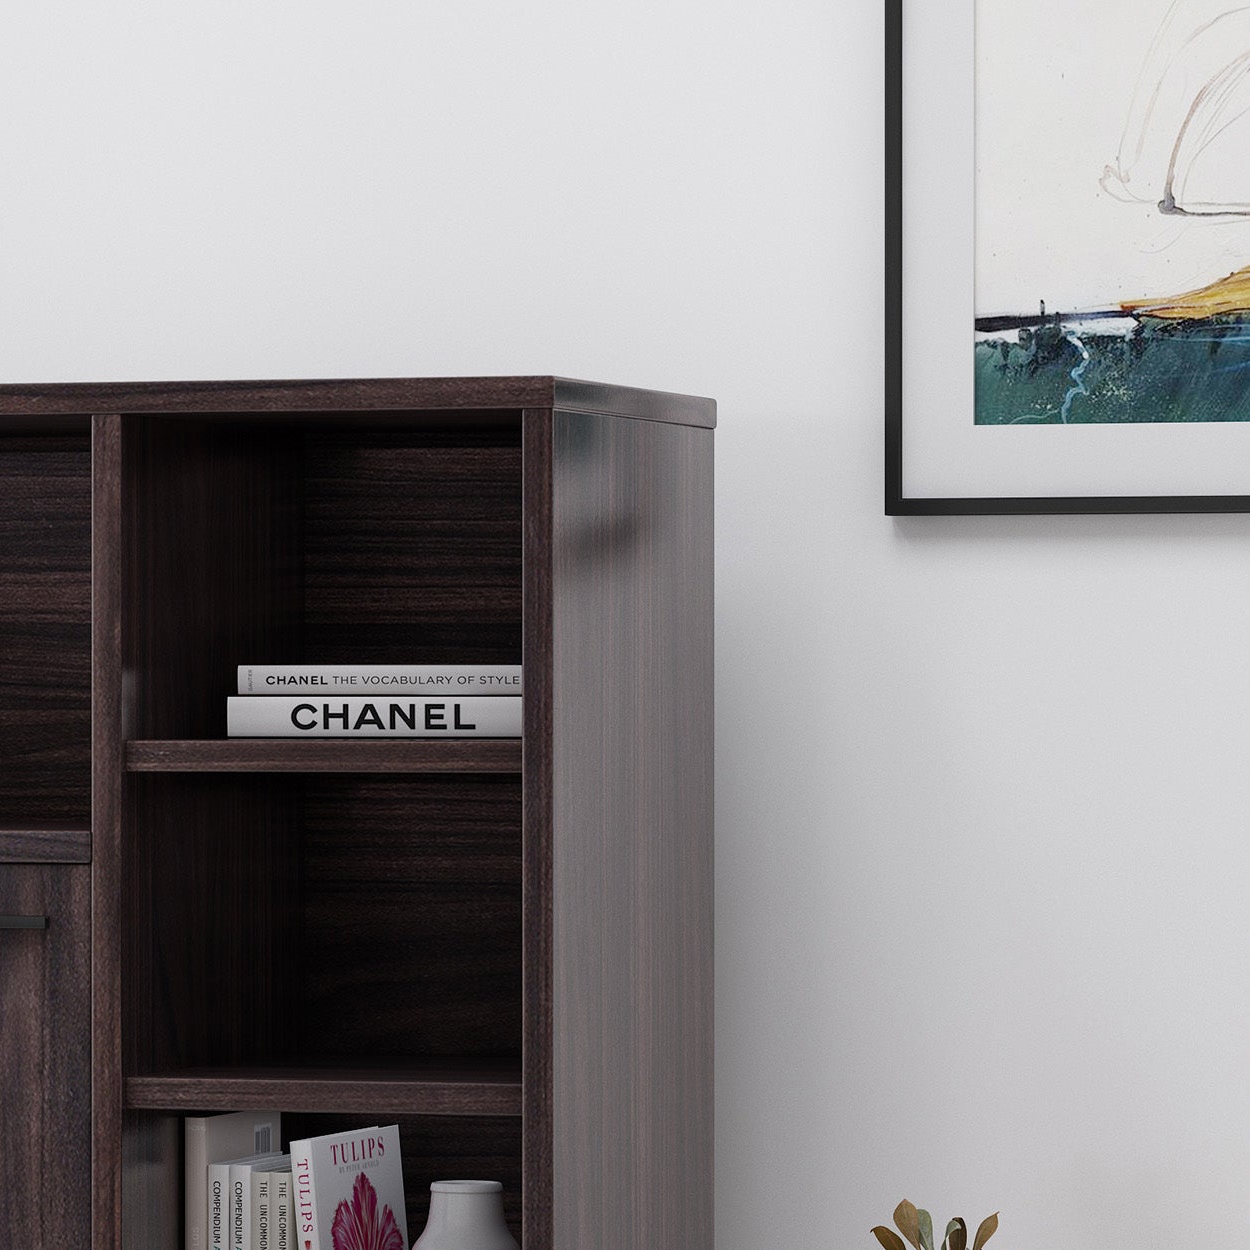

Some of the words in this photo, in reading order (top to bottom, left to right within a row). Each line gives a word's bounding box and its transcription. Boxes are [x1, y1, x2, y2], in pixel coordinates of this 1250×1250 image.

[265, 675, 328, 685] CHANEL
[333, 675, 358, 685] THE
[362, 675, 453, 685] VOCABULARY
[457, 675, 475, 685] OF
[479, 675, 520, 685] STYLE
[291, 703, 476, 730] CHANEL
[330, 1136, 385, 1165] TULIPS
[260, 1182, 268, 1198] THE
[278, 1182, 286, 1198] THE
[297, 1159, 314, 1232] TULIPS
[213, 1181, 221, 1244] COMPENDIUM
[234, 1182, 243, 1244] COMPENDIUM
